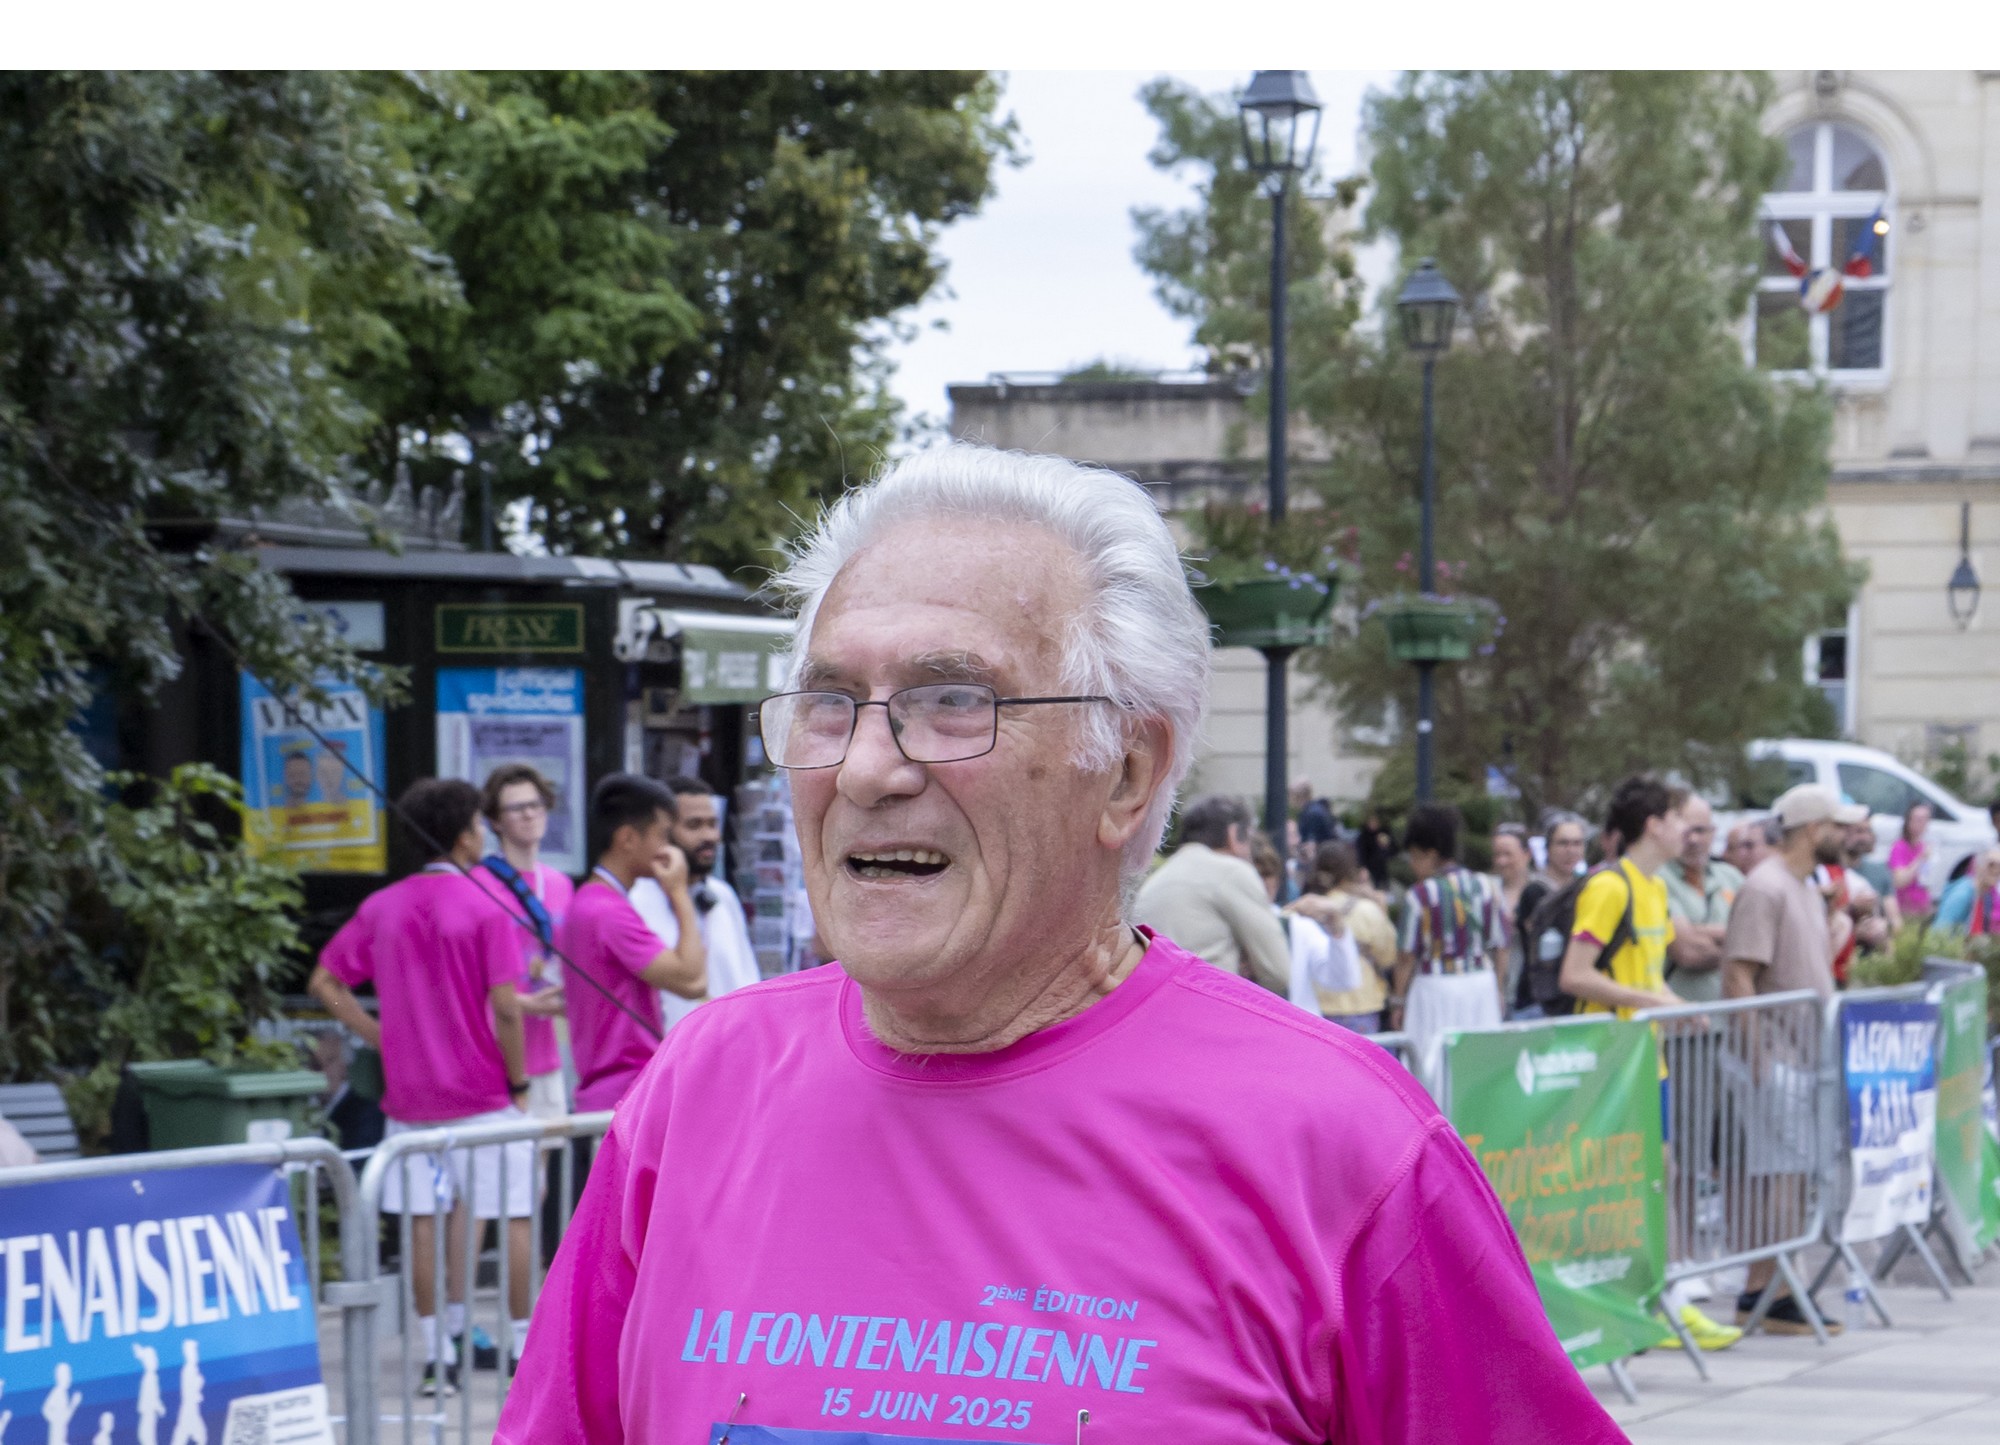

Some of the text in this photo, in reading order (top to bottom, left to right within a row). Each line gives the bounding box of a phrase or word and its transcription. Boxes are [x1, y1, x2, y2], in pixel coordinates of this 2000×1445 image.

[1033, 1283, 1139, 1322] ÉDITION
[680, 1308, 1159, 1394] LA FONTENAISIENNE
[820, 1387, 1034, 1431] 15 JUIN 2025
